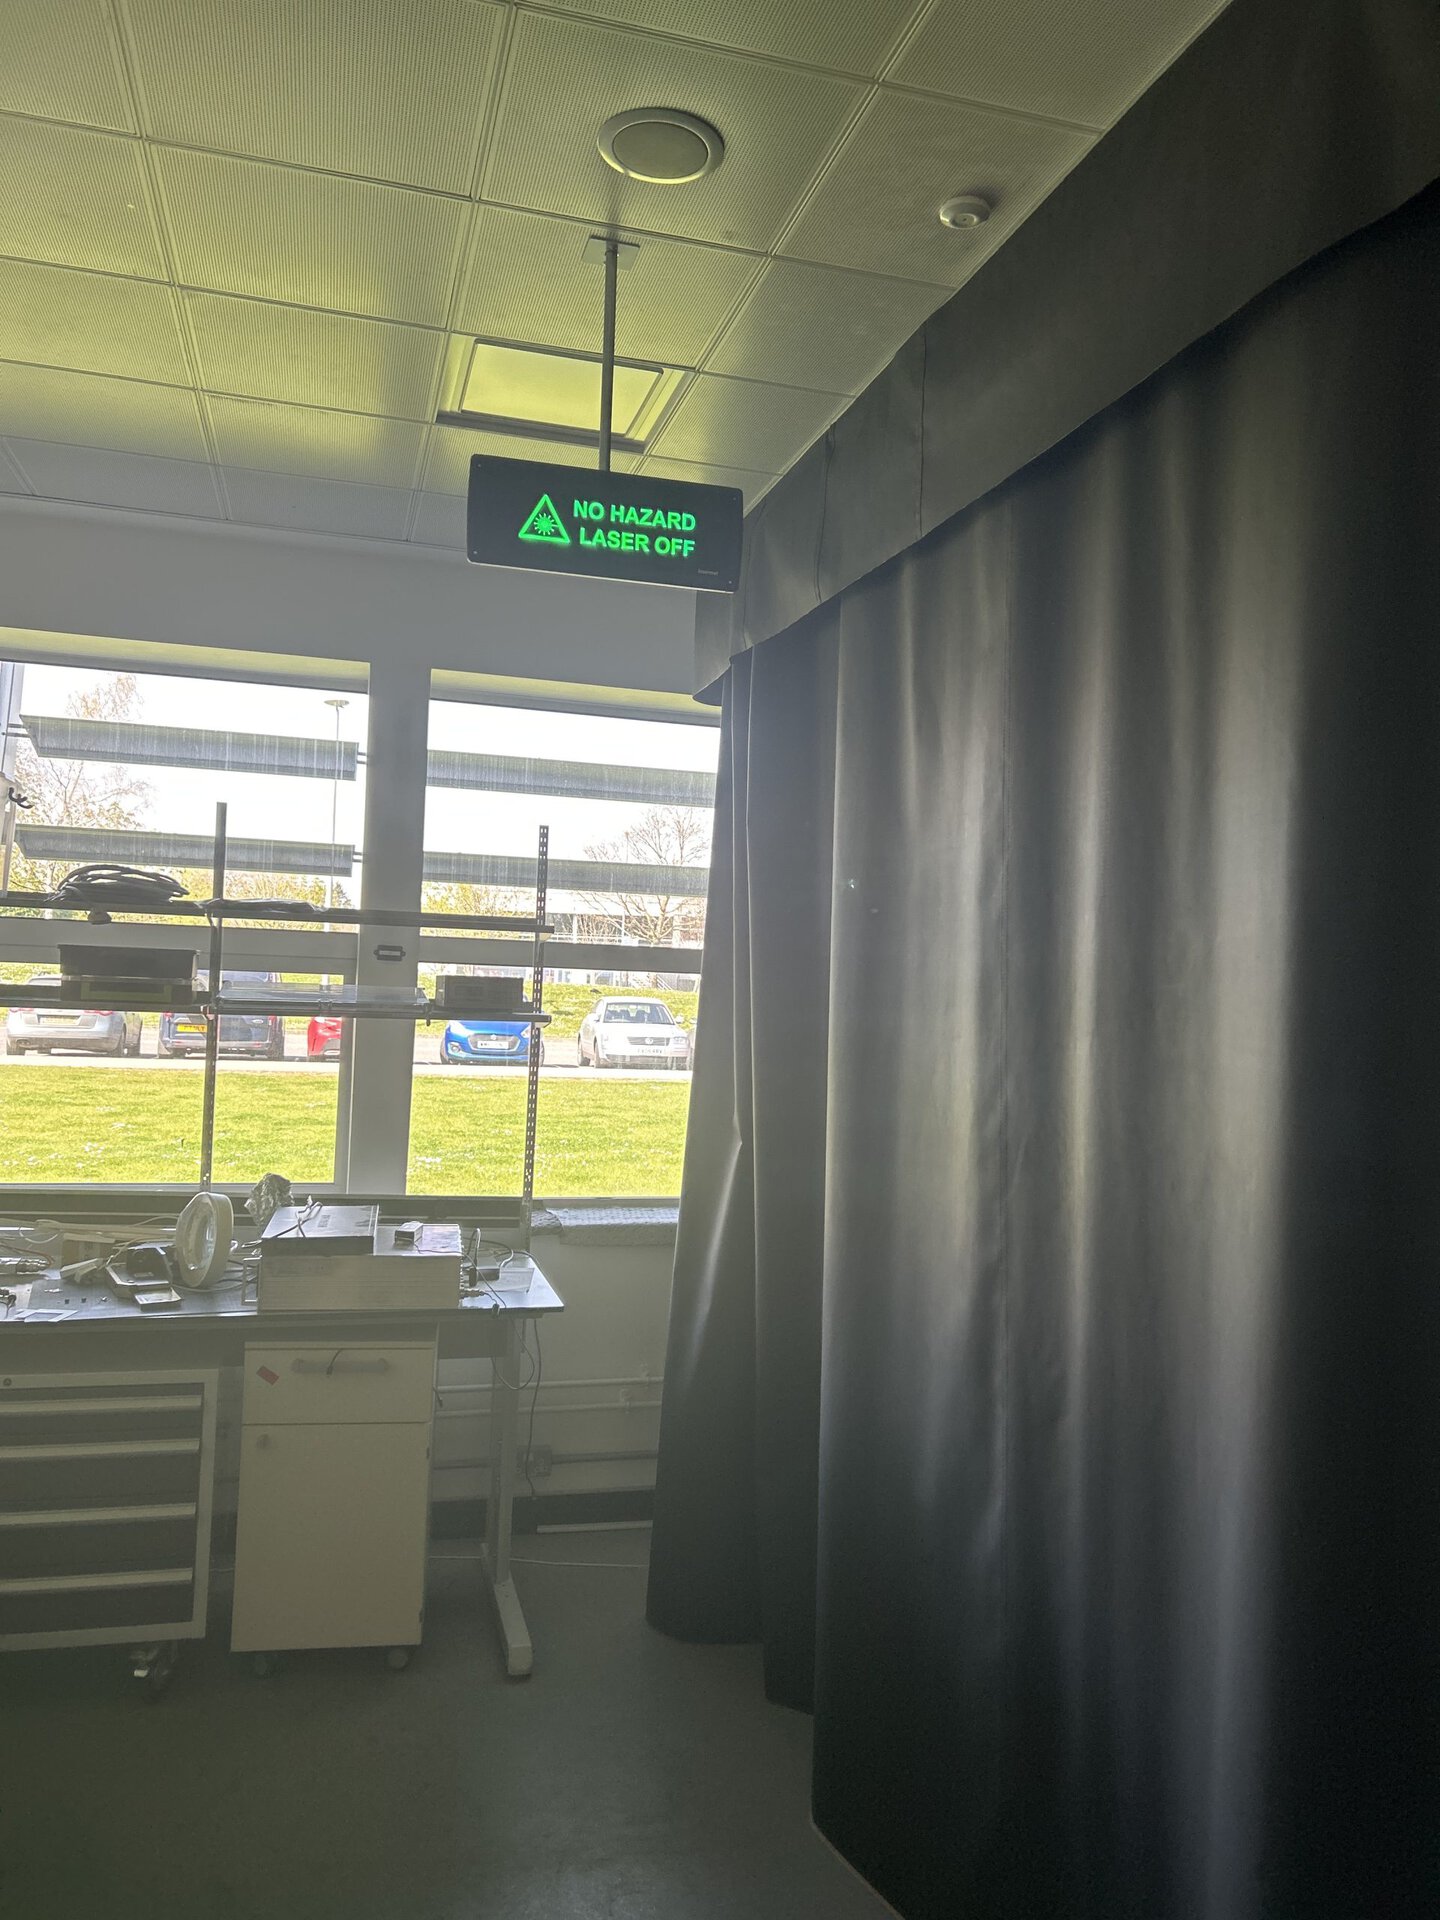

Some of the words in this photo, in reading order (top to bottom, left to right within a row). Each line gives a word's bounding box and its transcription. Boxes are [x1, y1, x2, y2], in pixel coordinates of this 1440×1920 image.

[573, 499, 605, 520] NO
[610, 504, 696, 531] HAZARD
[579, 527, 650, 553] LASER
[654, 536, 696, 557] OFF
